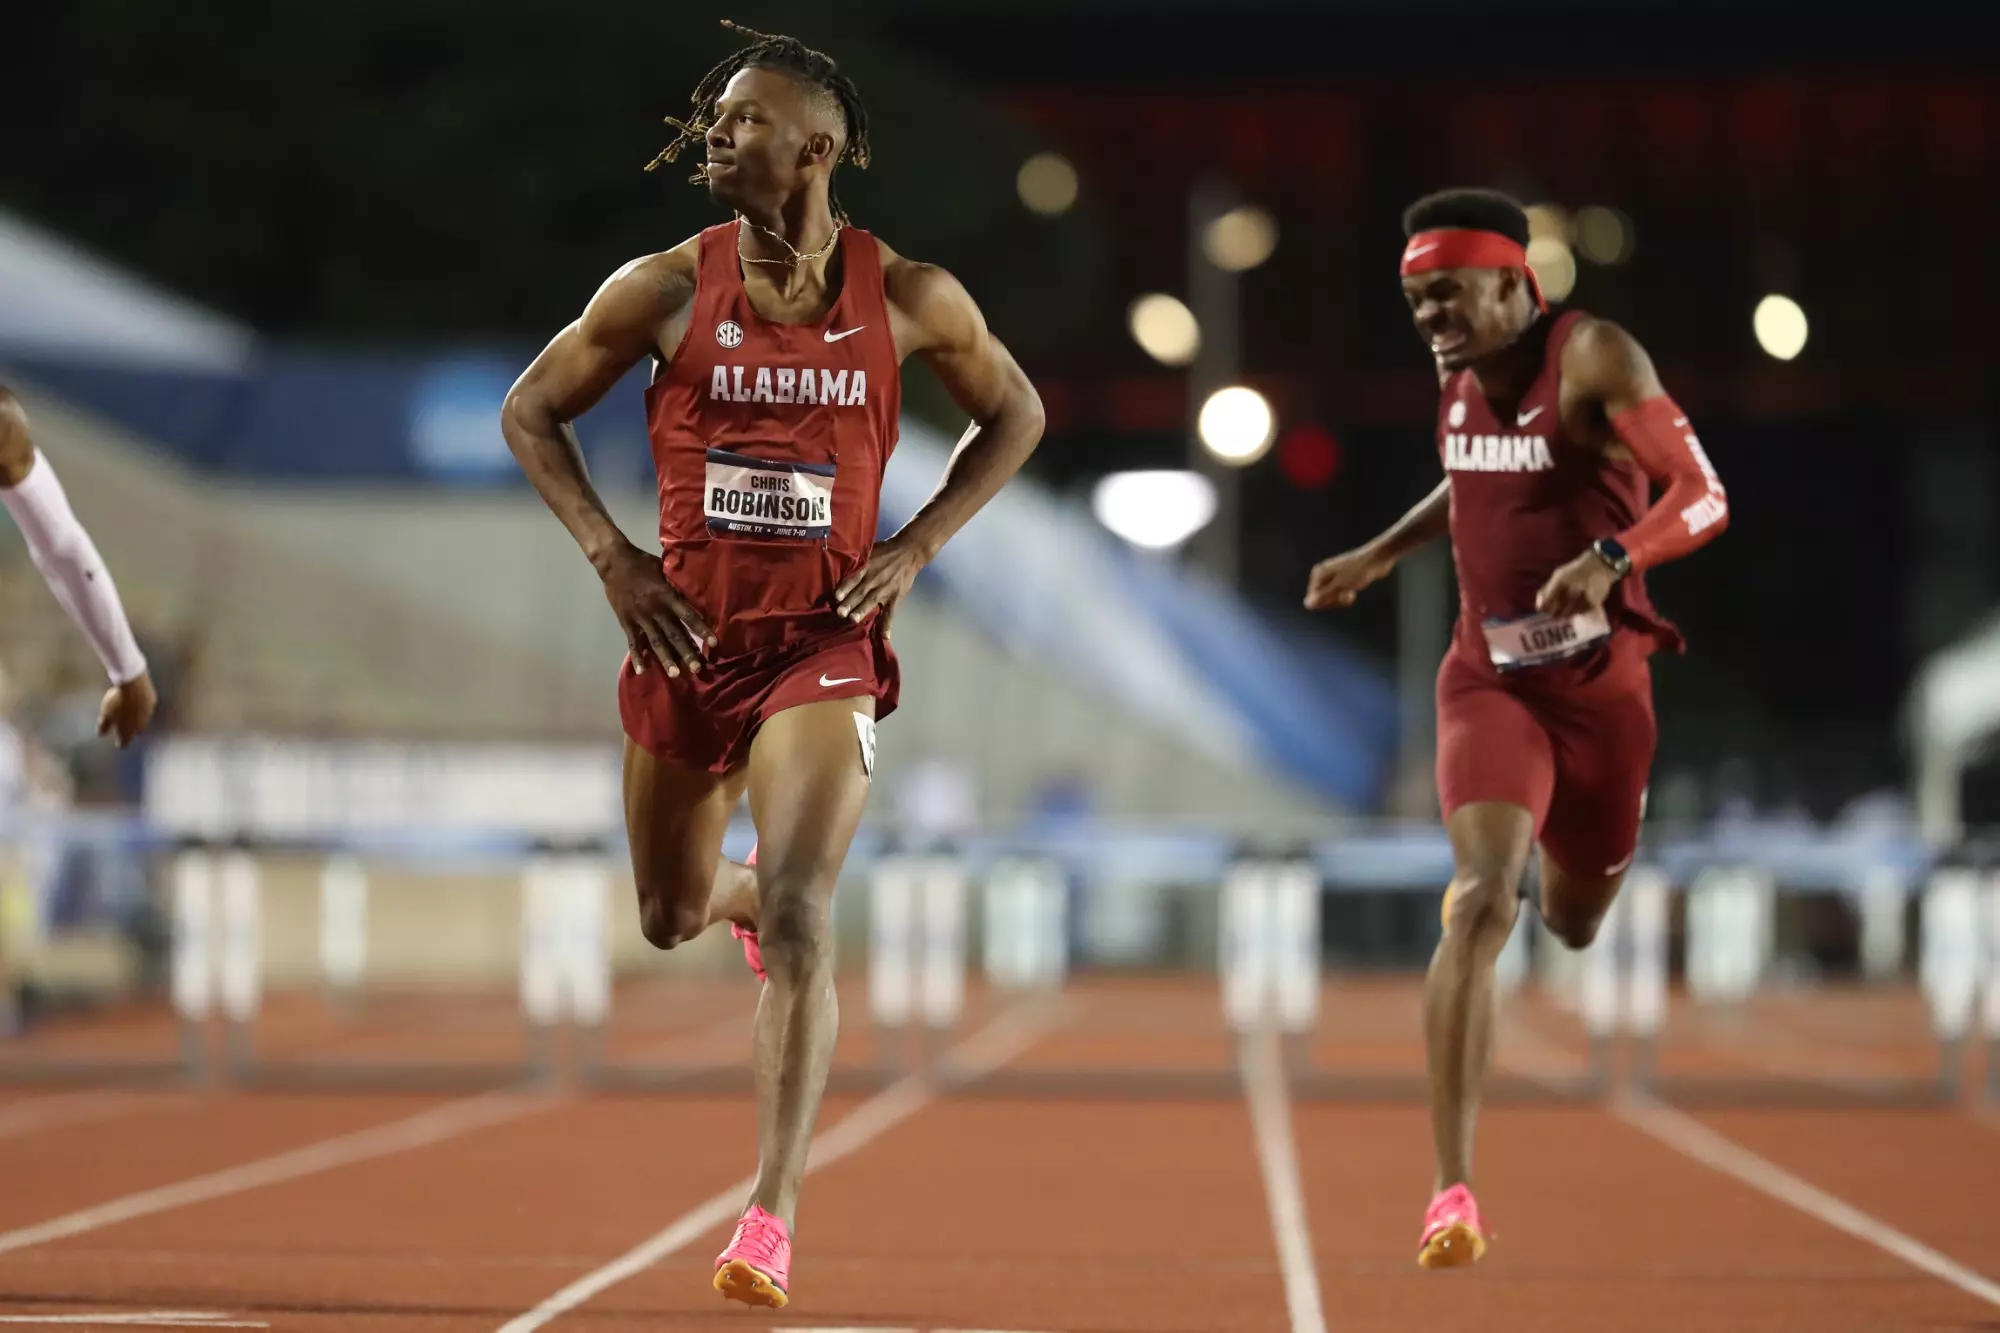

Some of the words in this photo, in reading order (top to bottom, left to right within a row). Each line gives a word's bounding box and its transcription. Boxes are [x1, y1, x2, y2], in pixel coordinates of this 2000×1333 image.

[719, 322, 741, 346] SEC
[710, 365, 867, 406] ALABAMA
[1444, 433, 1555, 472] ALABAMA
[750, 475, 790, 492] CHRIS
[711, 487, 825, 521] ROBINSON
[775, 528, 792, 536] JUNE
[1519, 624, 1577, 653] LONG
